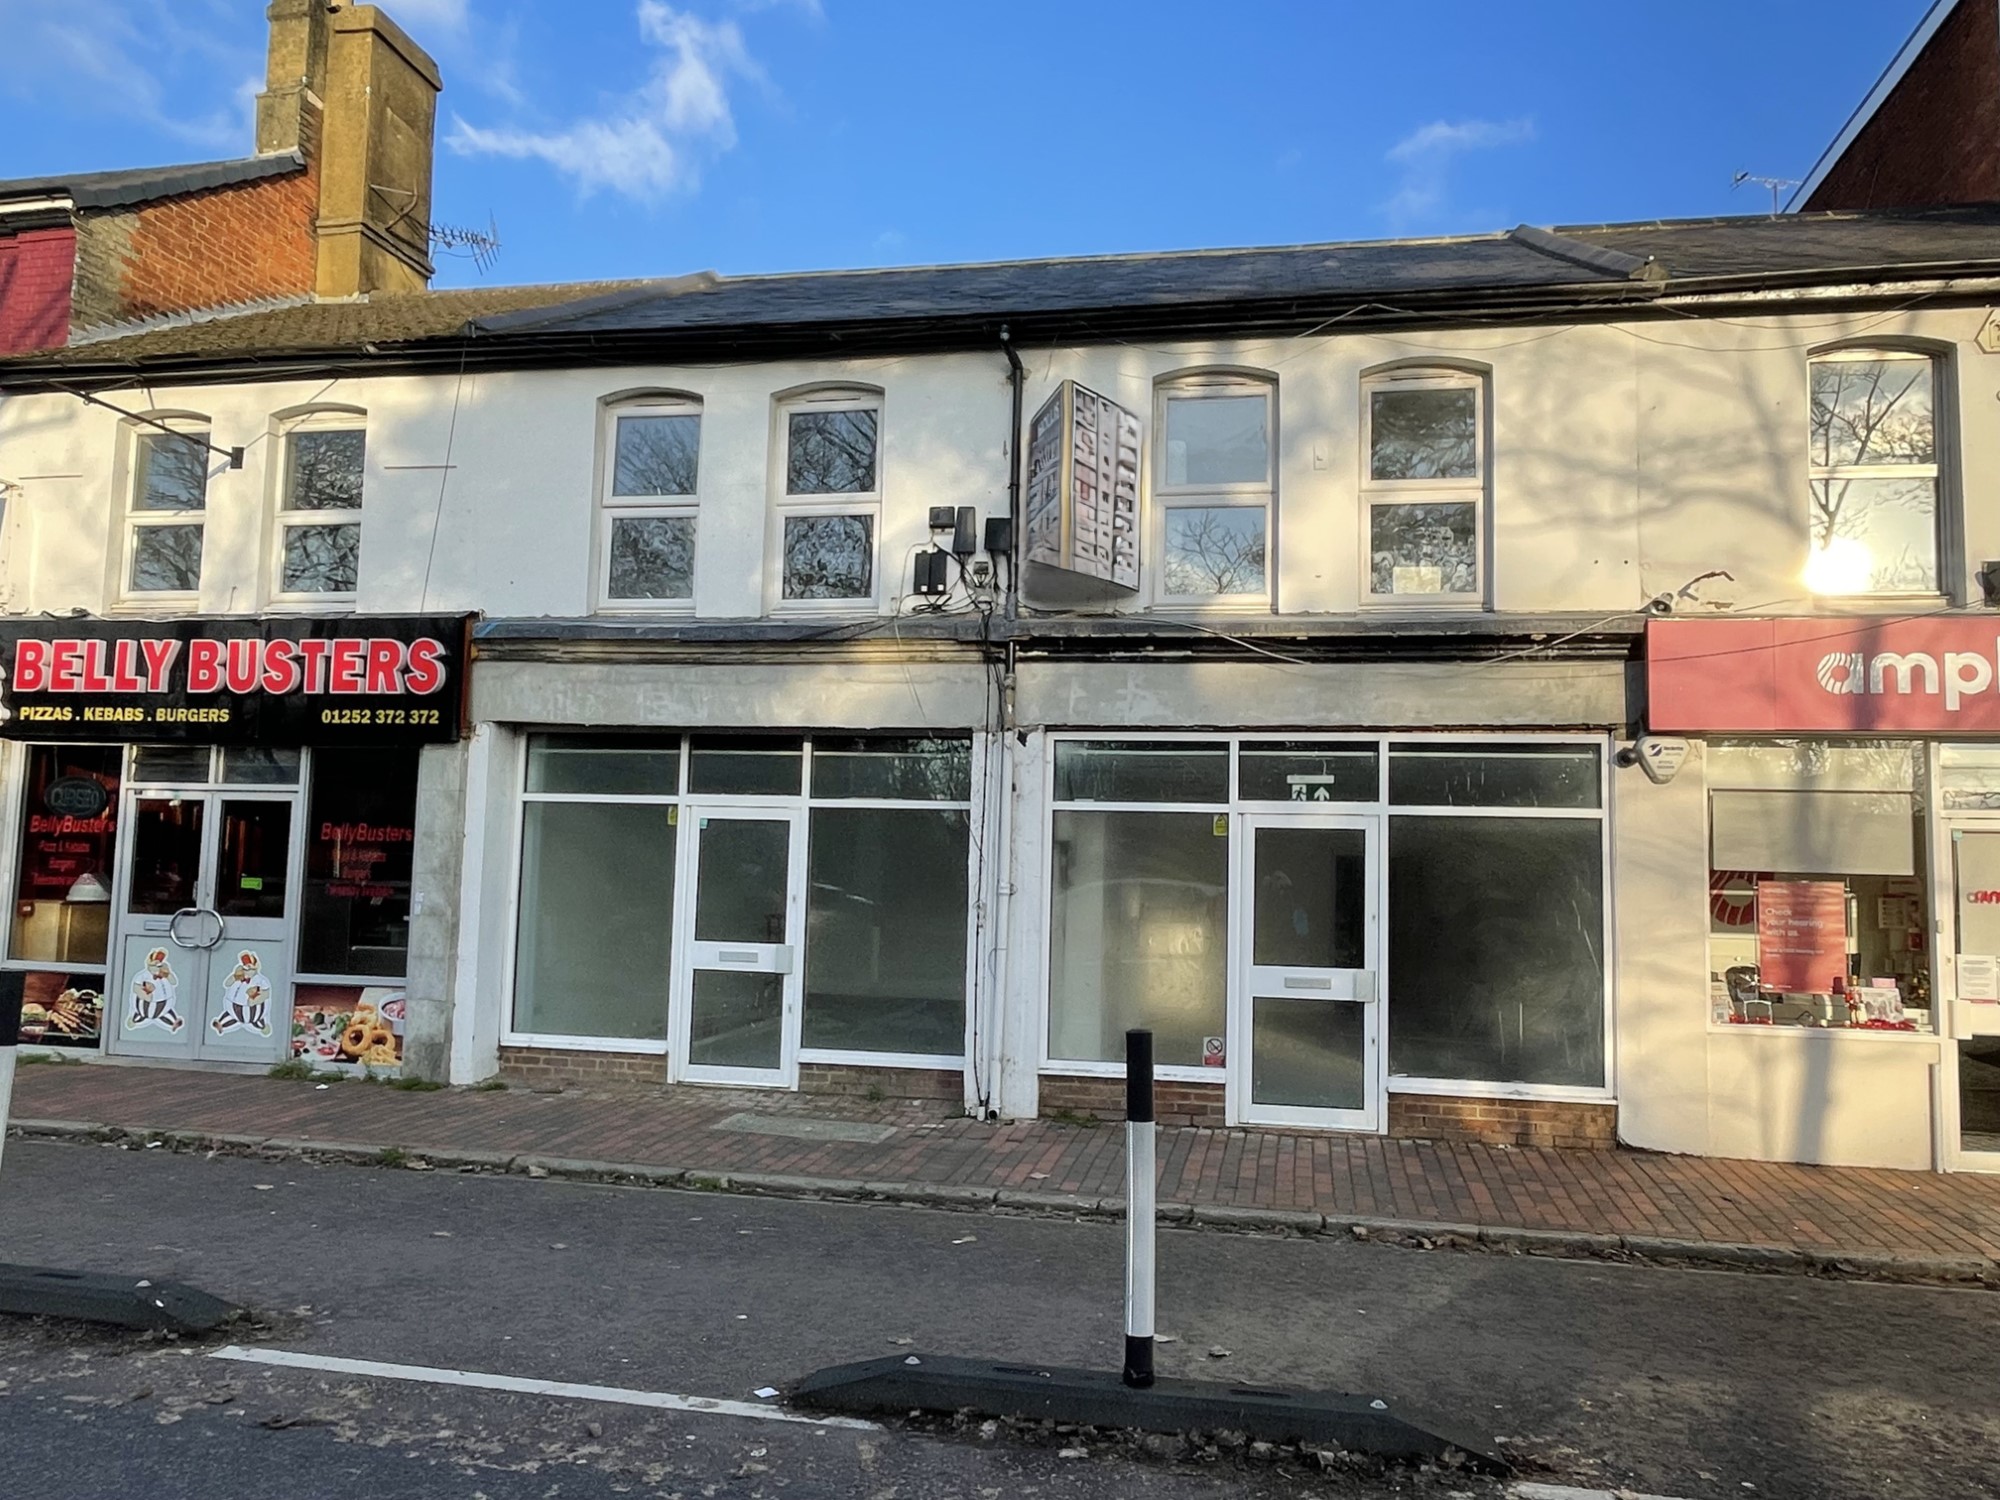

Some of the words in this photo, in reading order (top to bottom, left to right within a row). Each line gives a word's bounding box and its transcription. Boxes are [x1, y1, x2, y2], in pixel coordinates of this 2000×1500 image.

[13, 638, 182, 693] BELLY
[187, 638, 447, 695] BUSTERS
[1816, 635, 2000, 711] amp
[19, 706, 73, 721] PIZZAS
[83, 707, 144, 722] KEBABS
[155, 708, 230, 723] BURGERS
[321, 709, 371, 724] 01252
[375, 709, 405, 724] 372
[409, 710, 440, 724] 372
[30, 815, 115, 837] BellyBusters
[321, 823, 412, 845] BellyBusters
[1788, 919, 1823, 928] hearing
